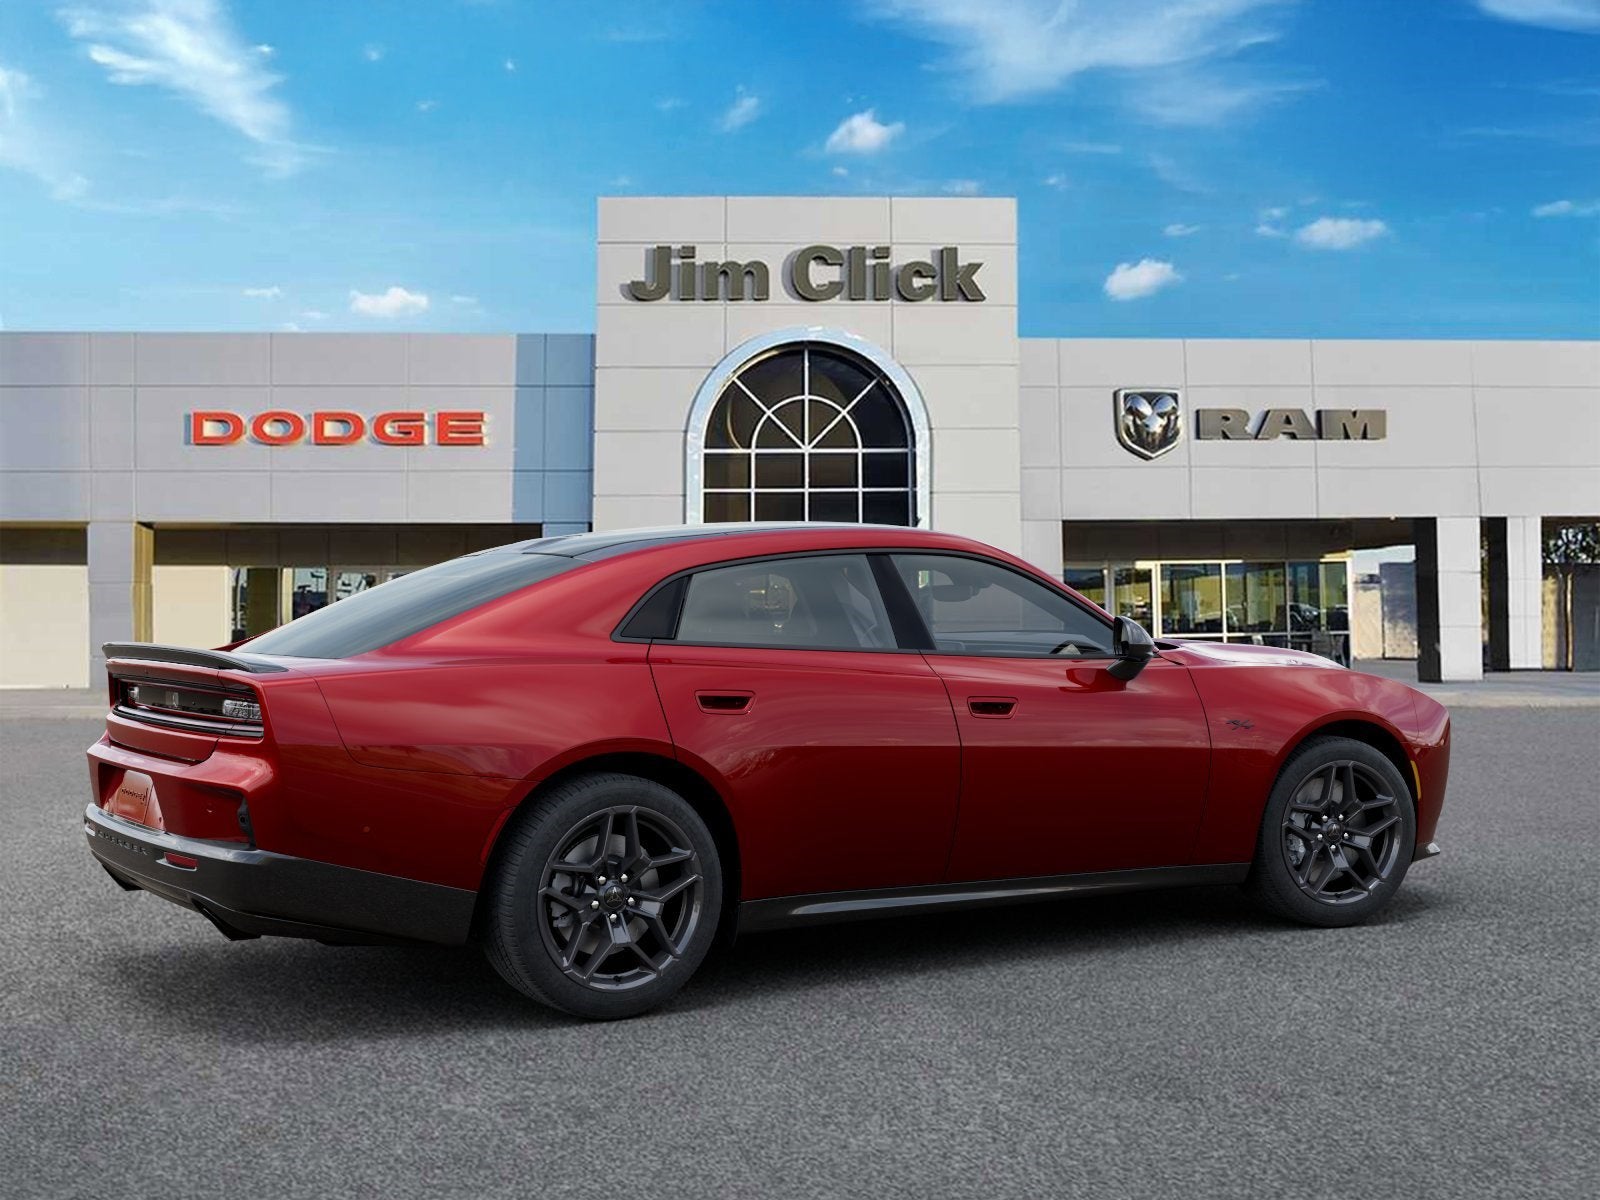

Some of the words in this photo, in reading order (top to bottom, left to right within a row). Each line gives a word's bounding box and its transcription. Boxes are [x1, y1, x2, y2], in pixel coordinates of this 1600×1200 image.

[627, 245, 769, 301] Jim
[792, 244, 986, 301] Click
[190, 410, 486, 446] DODGE
[1195, 409, 1387, 440] RAM
